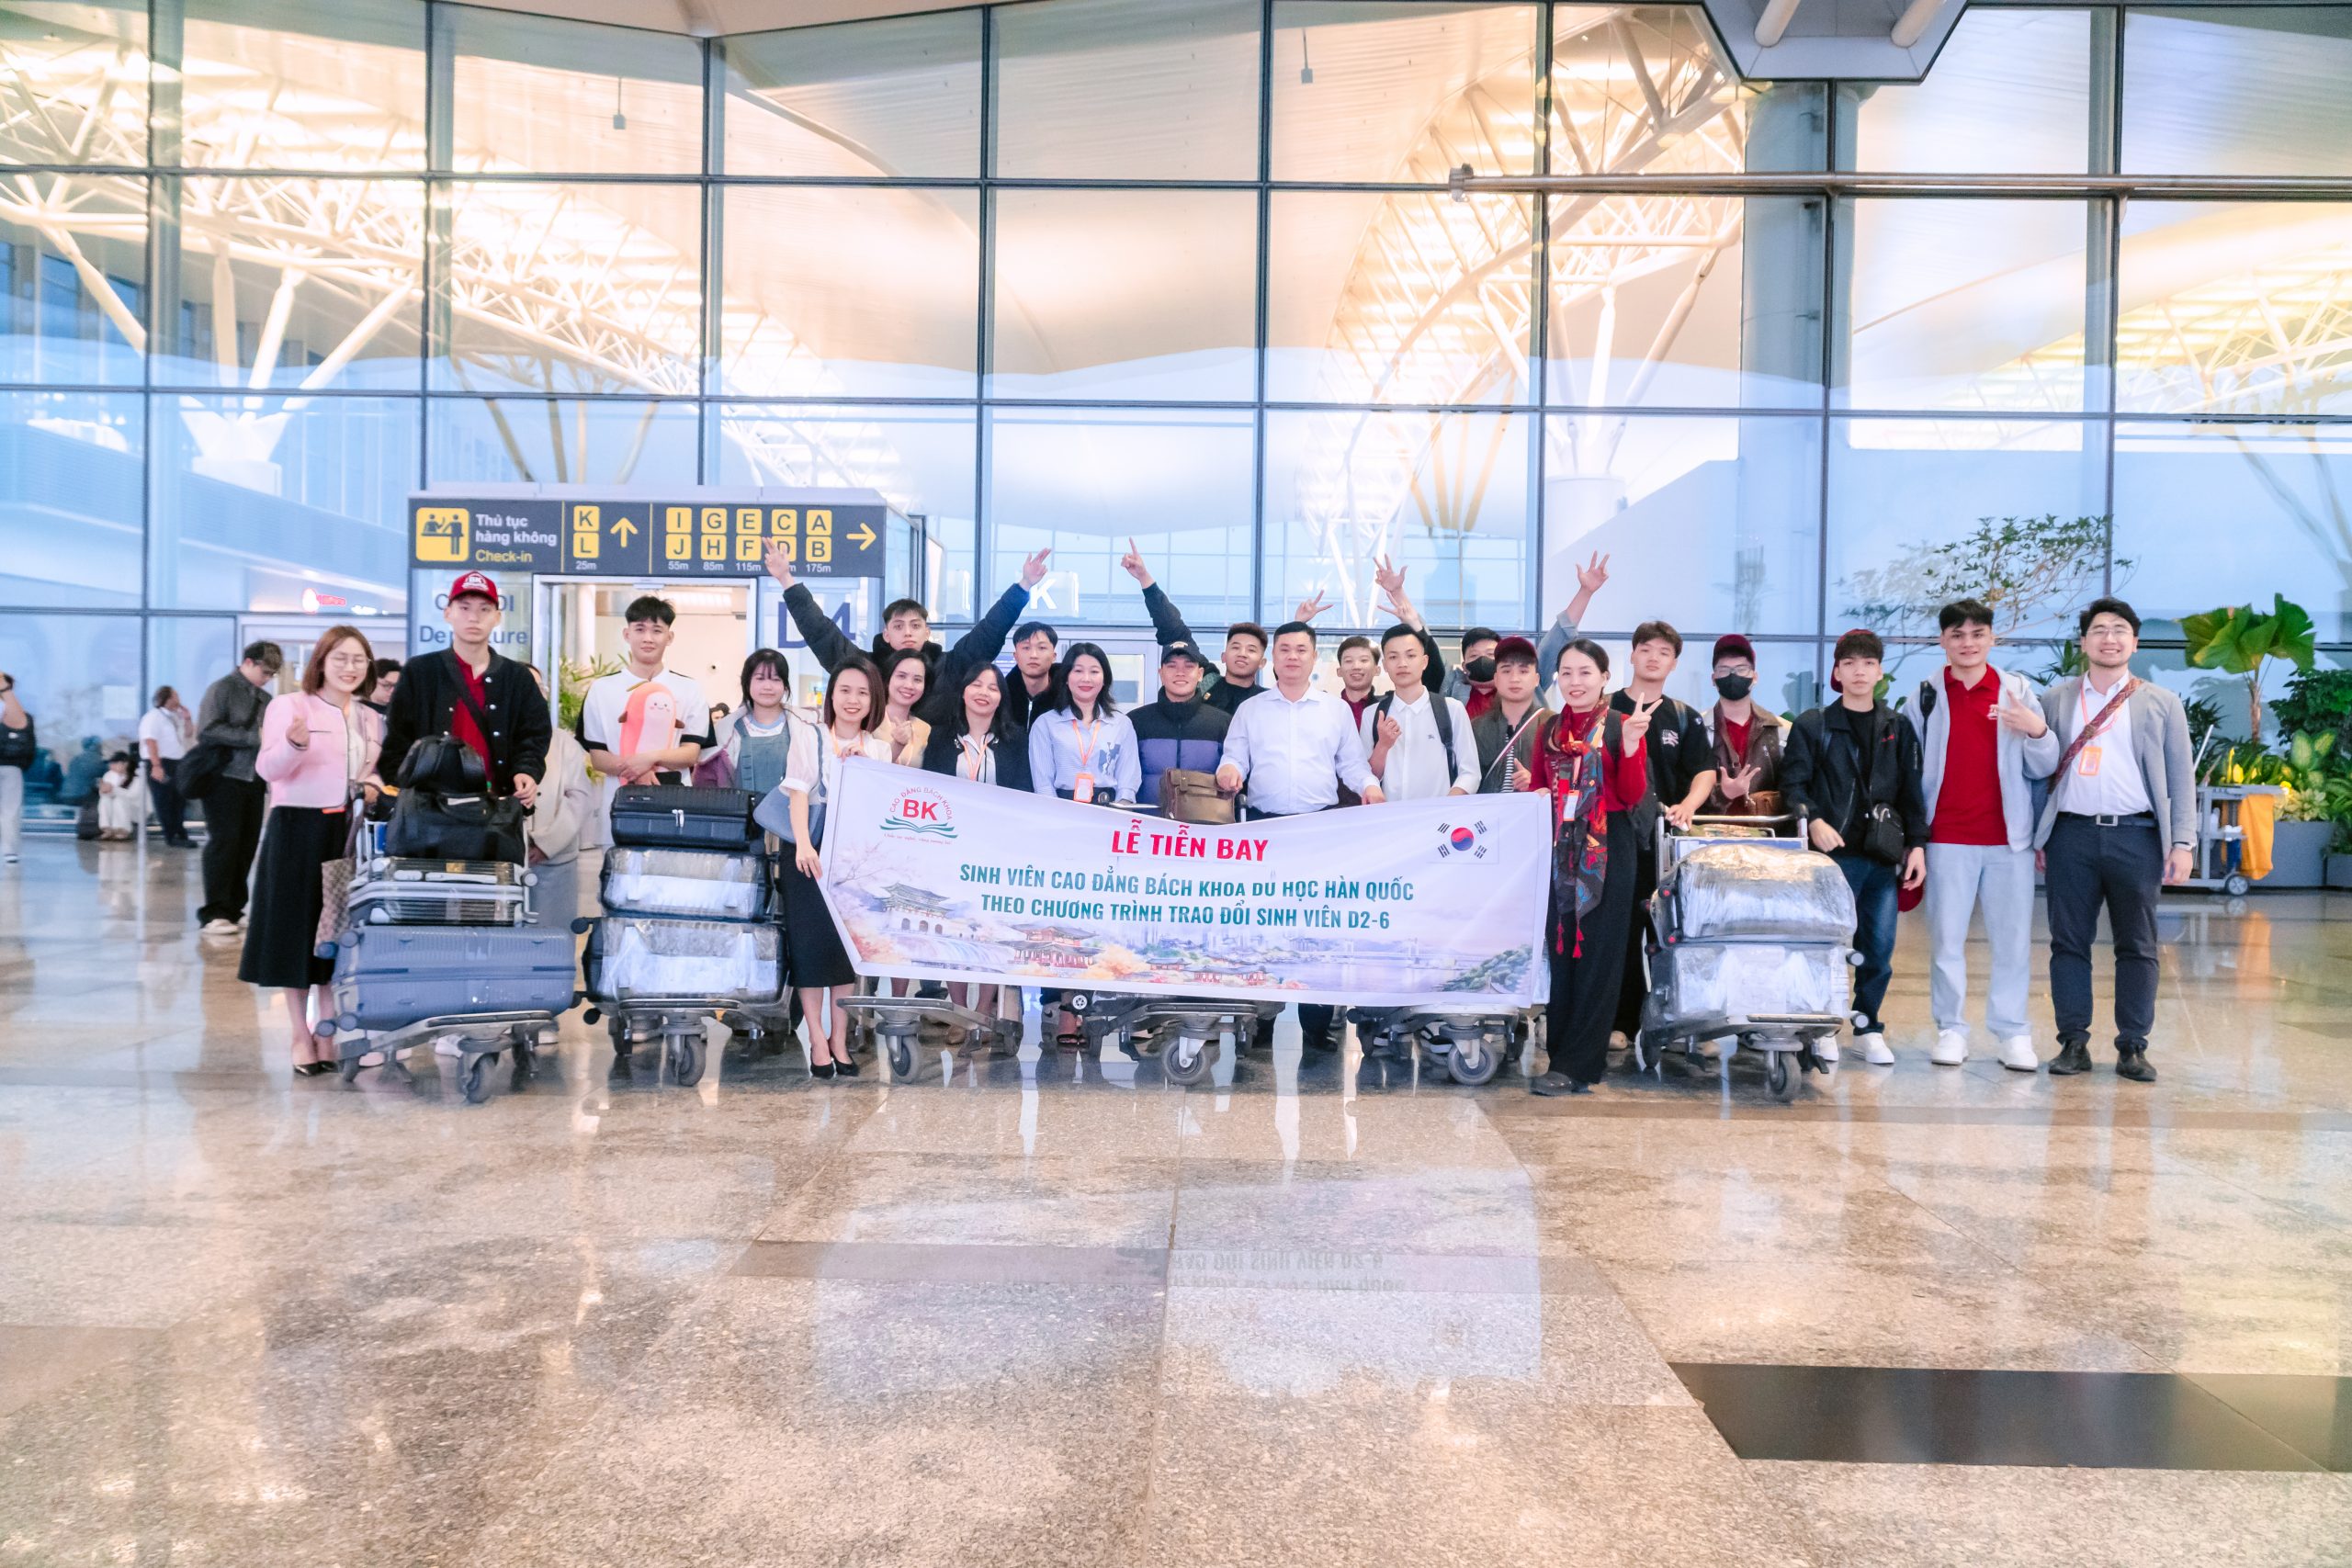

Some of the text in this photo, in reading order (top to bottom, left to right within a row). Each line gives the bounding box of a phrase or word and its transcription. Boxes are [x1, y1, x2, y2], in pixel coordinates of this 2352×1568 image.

[476, 513, 528, 531] Thủ tục
[579, 511, 593, 526] K
[707, 513, 721, 529] G
[742, 513, 755, 530] E
[777, 514, 791, 530] C
[811, 514, 827, 531] A
[476, 530, 558, 547] hàng không
[581, 537, 592, 553] L
[475, 549, 533, 563] Check-in
[673, 539, 684, 555] J
[707, 539, 720, 556] H
[742, 540, 754, 556] F
[812, 541, 825, 558] B
[575, 560, 596, 570] 25m
[668, 561, 689, 570] 55m
[703, 561, 724, 571] 85m
[736, 563, 762, 572] 115m
[806, 564, 831, 573] 175m
[889, 797, 900, 813] CAO
[942, 799, 953, 820] KHOA
[902, 798, 938, 820] BK
[1112, 818, 1269, 862] LỄ TIỄN BAY
[960, 863, 1414, 902] SINH VIÊN CAO ĐẲNG BÁCH KHOA DU HỌC HÀN QUỐC
[981, 894, 1390, 930] THEO CHƯƠNG TRÌNH TRAO ĐỔI SINH VIÊN D2-6
